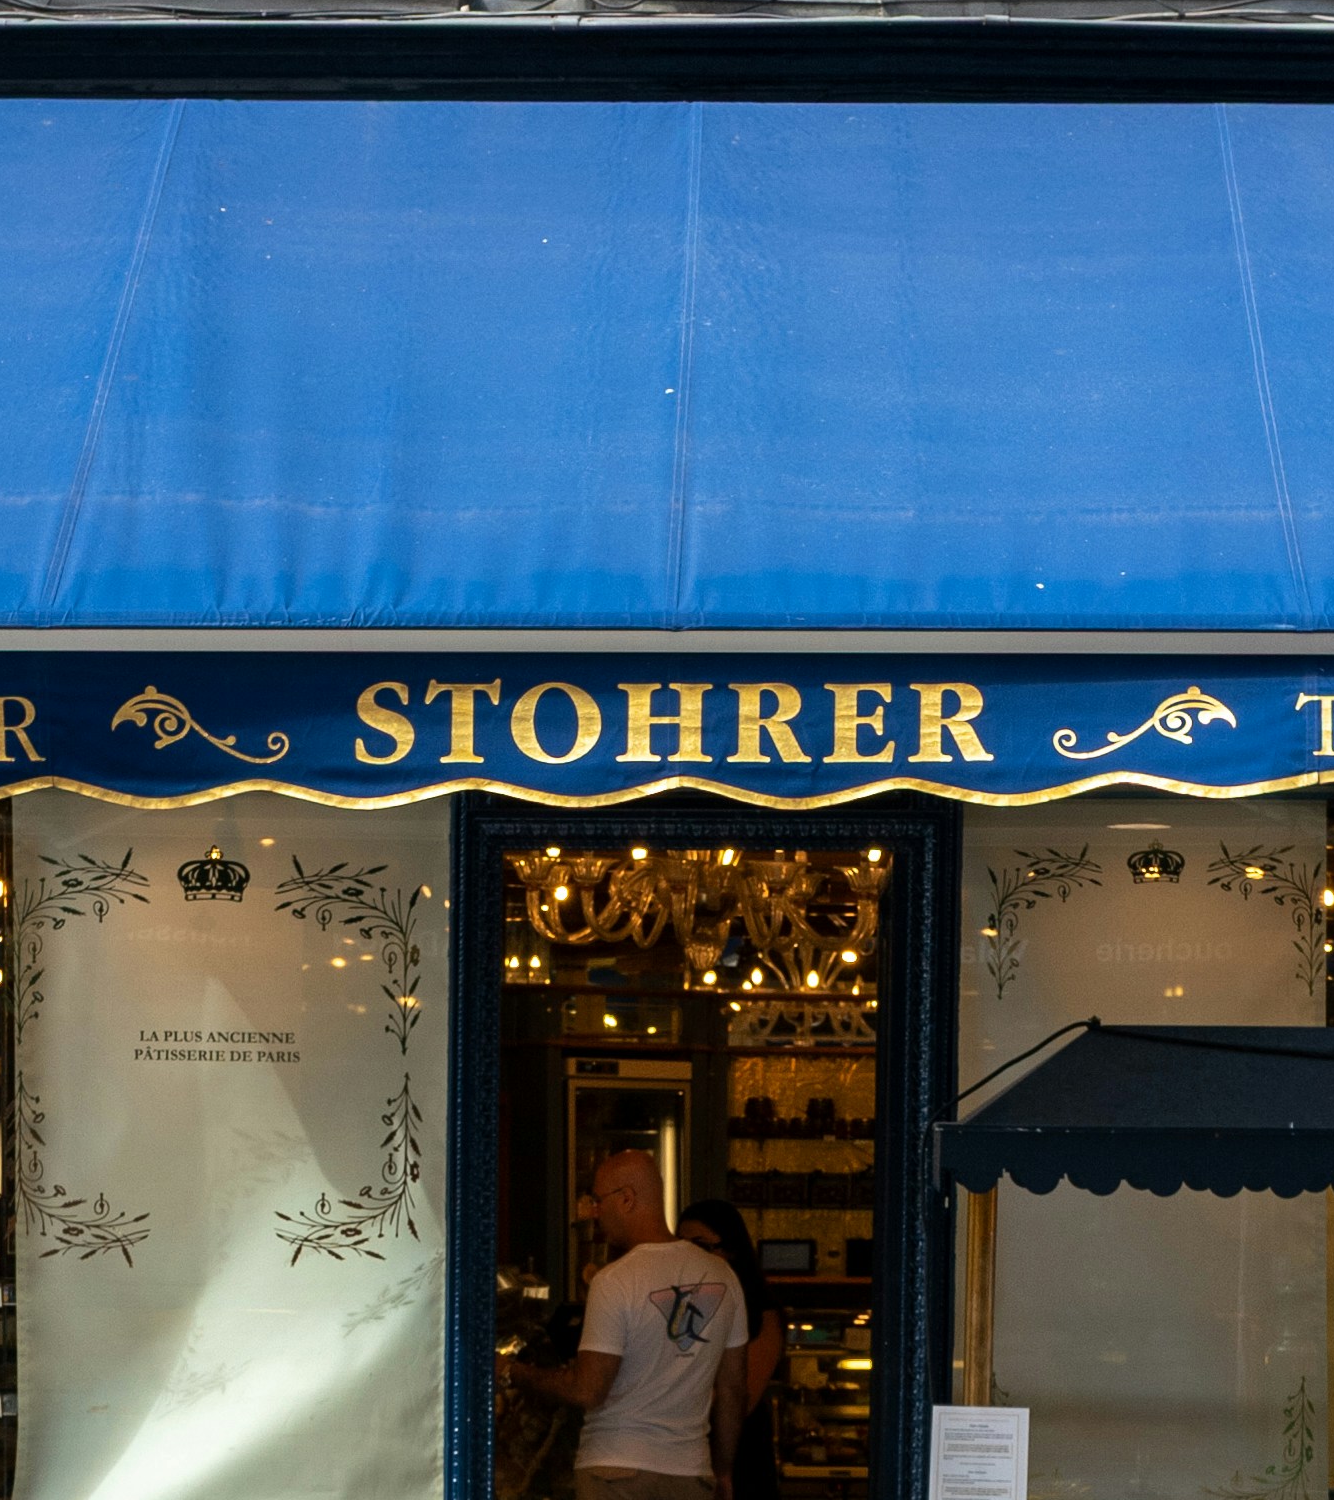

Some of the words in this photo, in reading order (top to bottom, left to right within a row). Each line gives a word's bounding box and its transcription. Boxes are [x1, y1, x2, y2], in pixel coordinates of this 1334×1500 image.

[355, 678, 995, 766] STOHRER
[140, 1030, 159, 1042] LA
[164, 1031, 202, 1043] PLUS
[206, 1032, 296, 1044] ANCIENNE
[134, 1046, 225, 1061] PÂTISSERIE
[230, 1051, 252, 1062] DE
[257, 1051, 301, 1062] PARIS
